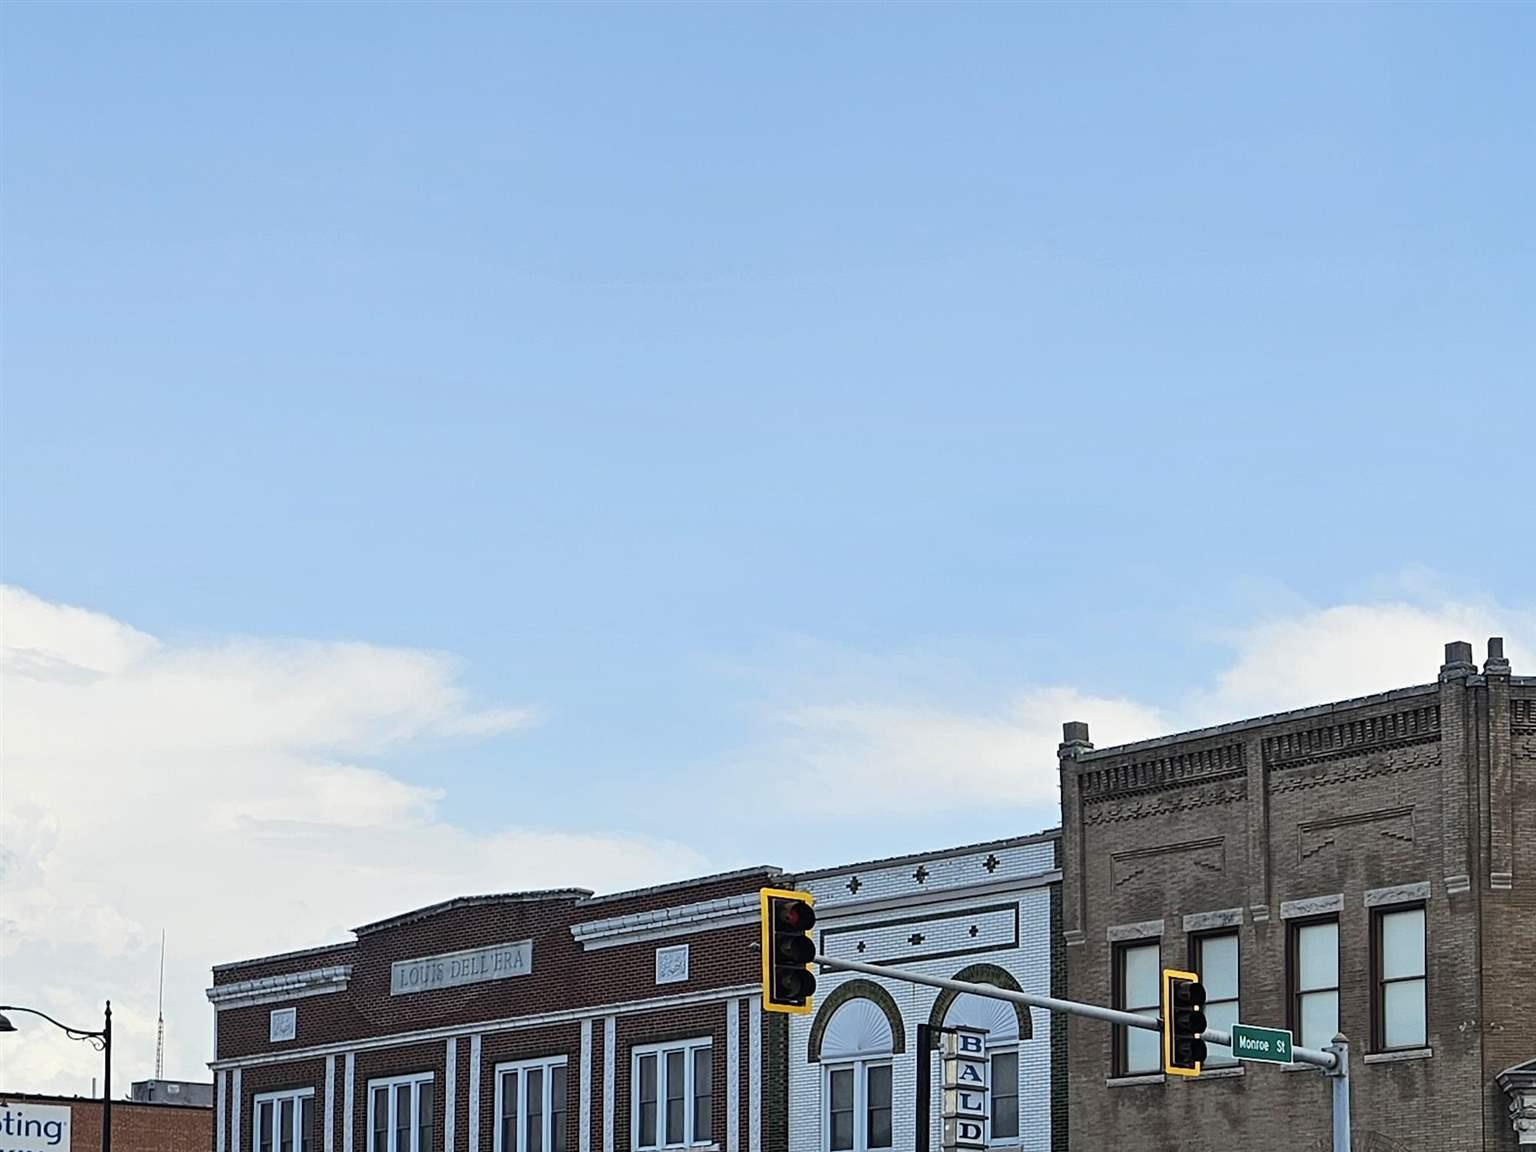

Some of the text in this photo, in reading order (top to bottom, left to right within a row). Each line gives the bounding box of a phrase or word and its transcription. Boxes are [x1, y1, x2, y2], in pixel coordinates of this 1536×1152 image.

[400, 950, 524, 988] LOUIS DELL'ERA
[1239, 1035, 1287, 1054] Monroe St
[0, 1111, 62, 1145] ting
